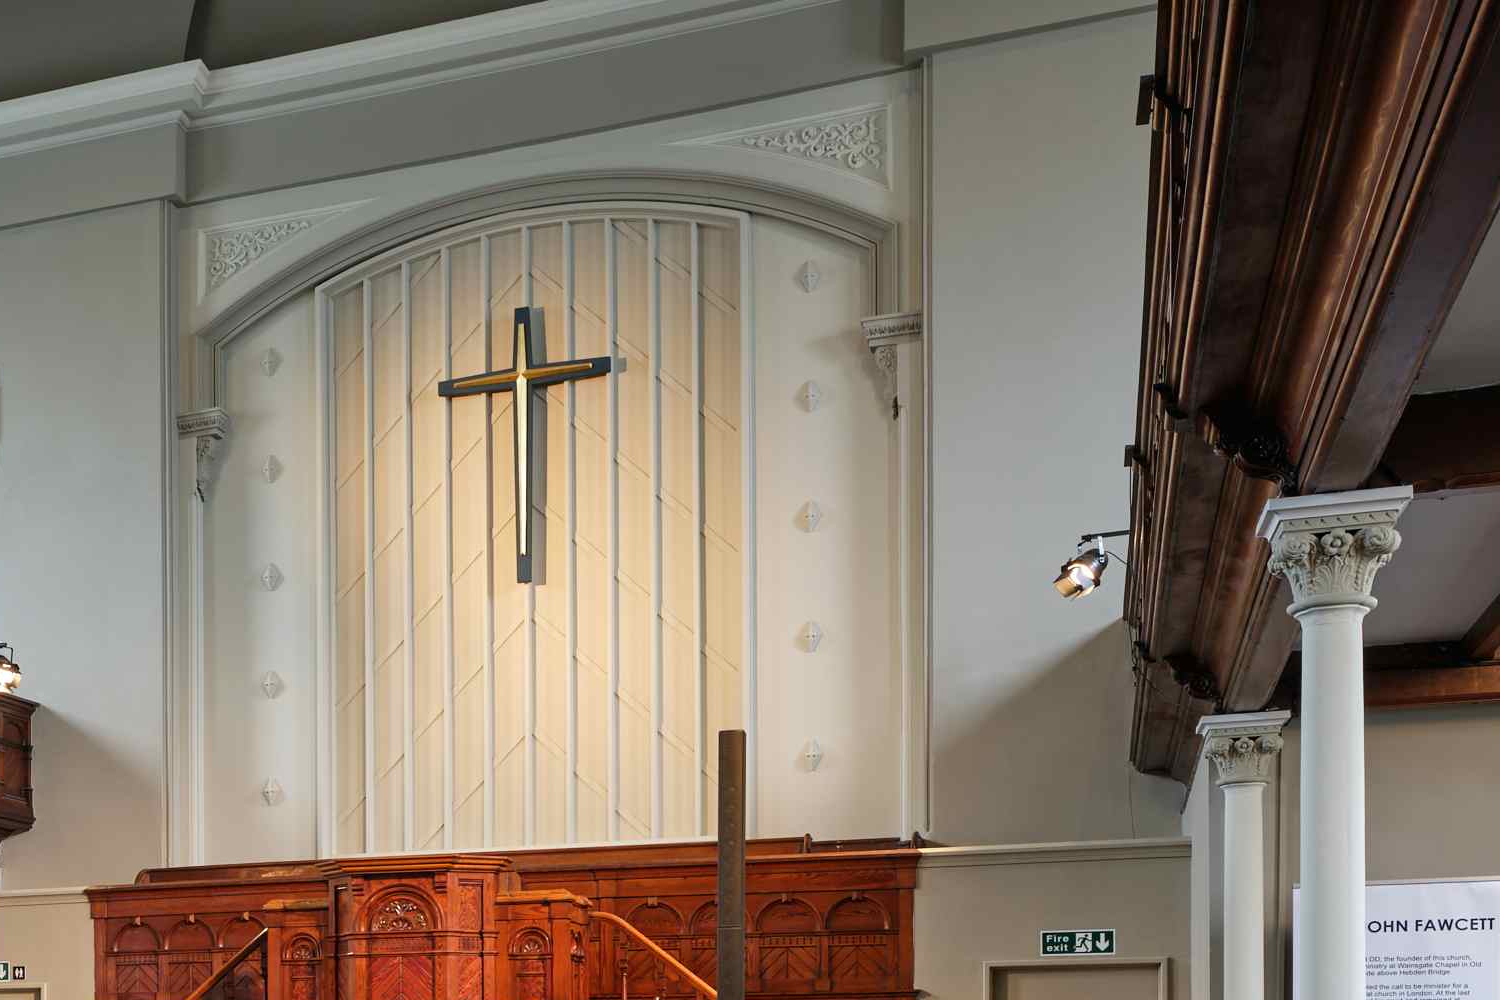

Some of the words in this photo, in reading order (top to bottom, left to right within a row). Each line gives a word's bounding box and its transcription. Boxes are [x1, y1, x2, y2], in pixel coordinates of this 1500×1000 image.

[1367, 920, 1408, 933] OHN
[1415, 918, 1495, 931] FAWCETT
[1046, 934, 1069, 943] Fire
[1046, 944, 1069, 952] exit
